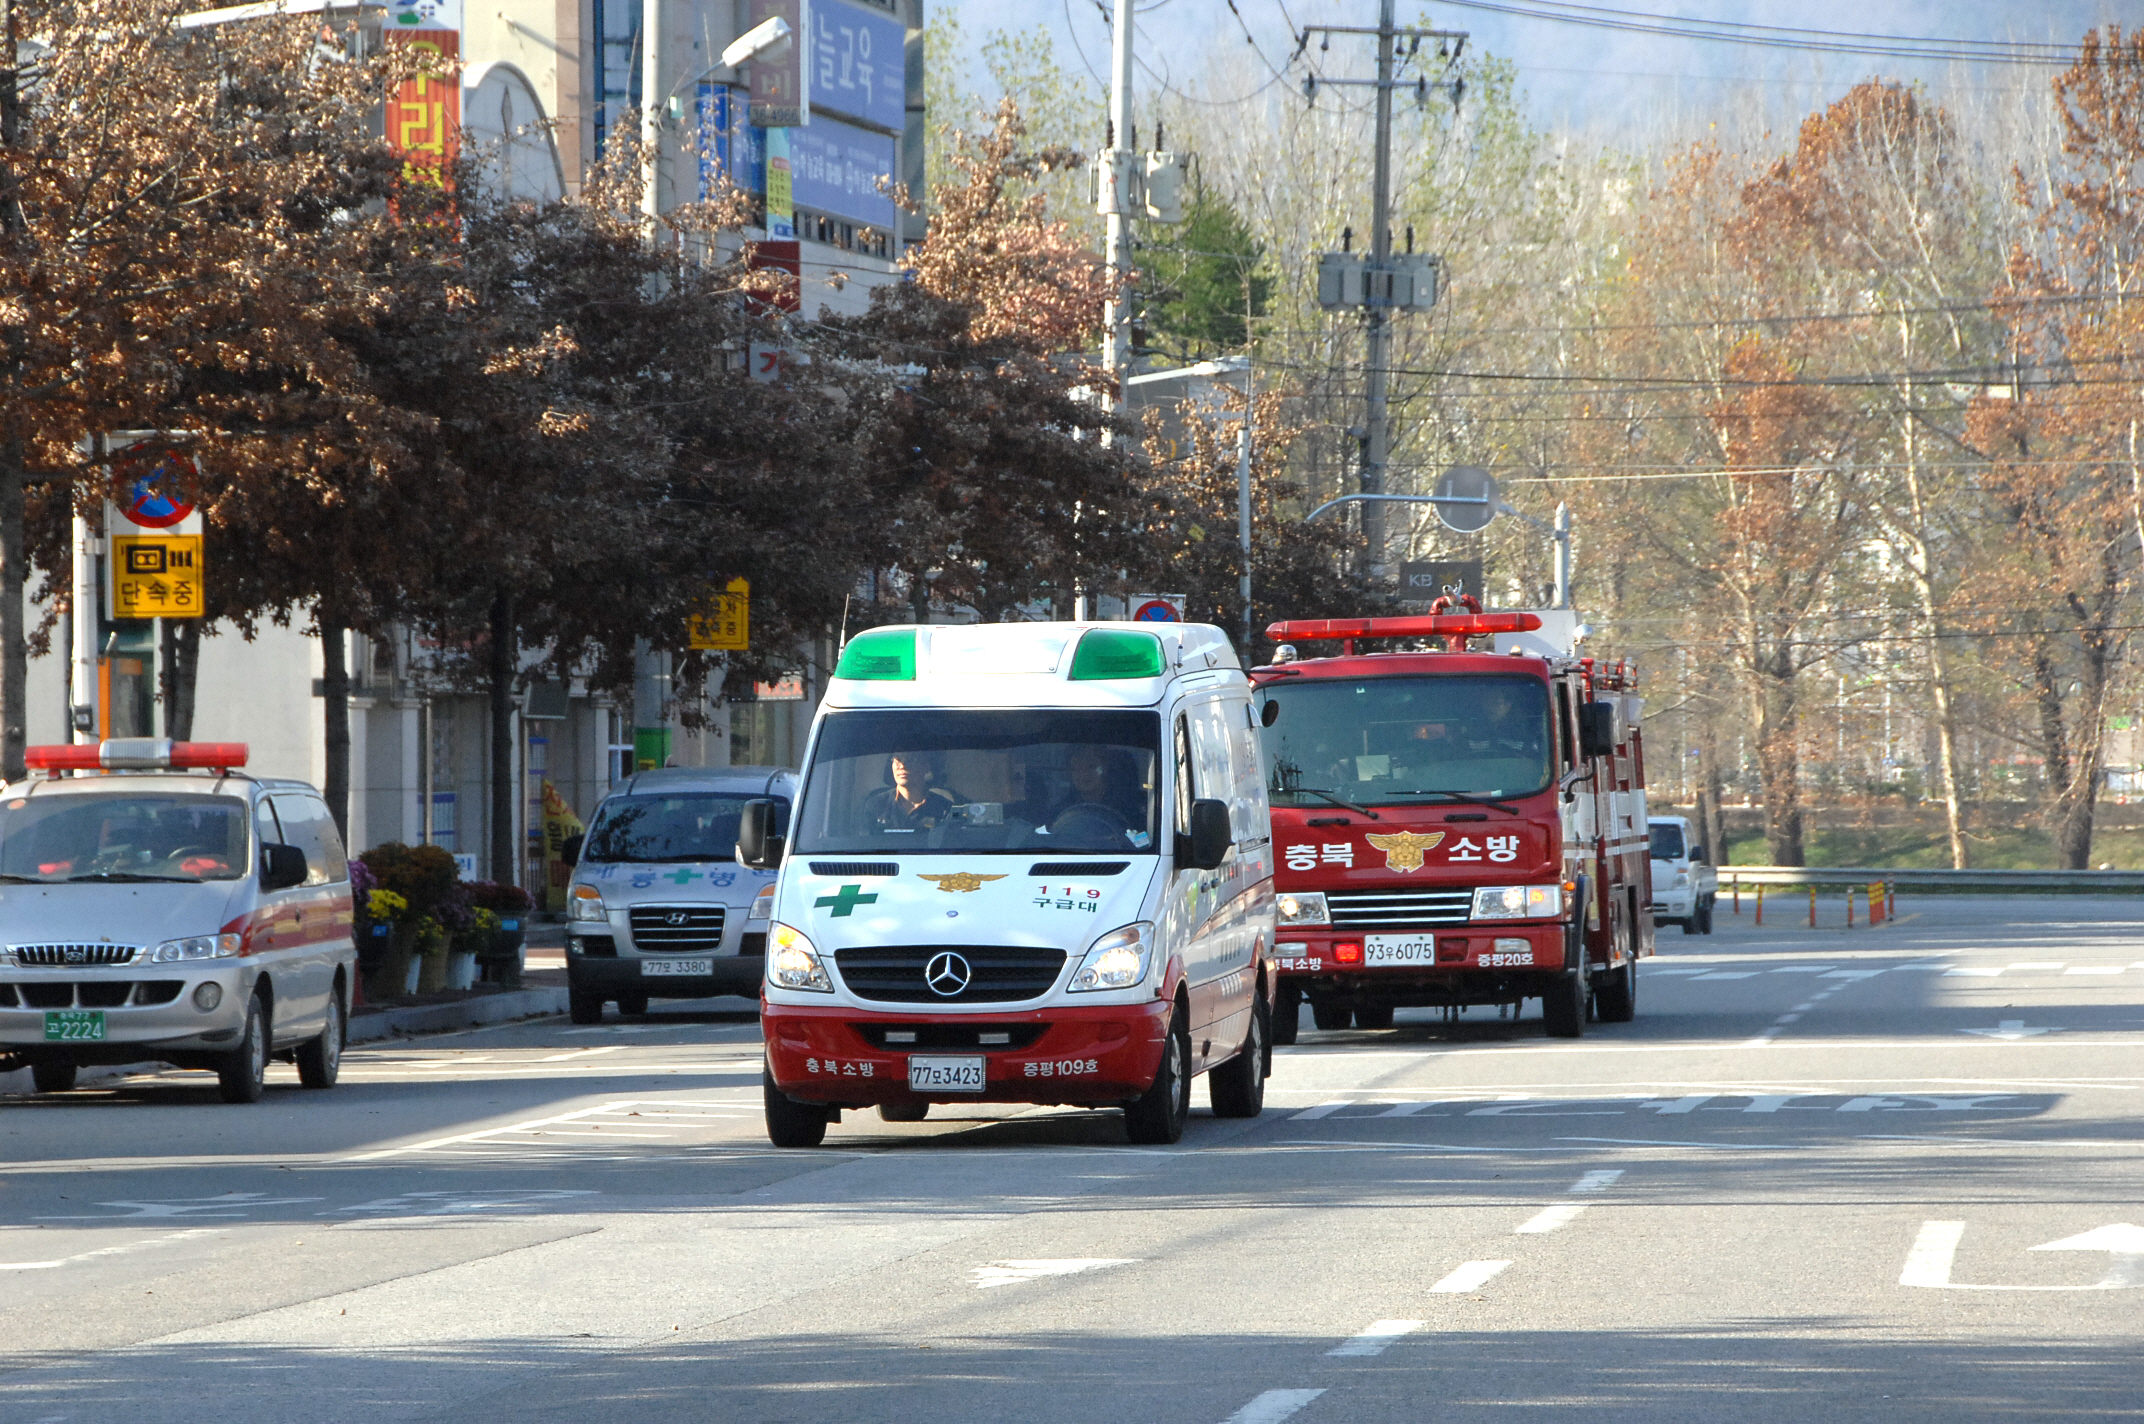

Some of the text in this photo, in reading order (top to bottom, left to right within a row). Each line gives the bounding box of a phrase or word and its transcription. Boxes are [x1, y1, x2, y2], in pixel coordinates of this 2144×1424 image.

[810, 7, 873, 104] 늘교육
[1409, 574, 1433, 587] KB
[121, 579, 193, 606] 단속중
[1285, 835, 1521, 871] 충북 소방
[1032, 897, 1098, 913] 구급대
[1367, 943, 1432, 961] 93우6075
[1478, 953, 1535, 968] 증평20호
[806, 1057, 874, 1077] 충북소방
[912, 1066, 981, 1085] 77모3423
[1023, 1059, 1099, 1077] 증평109호
